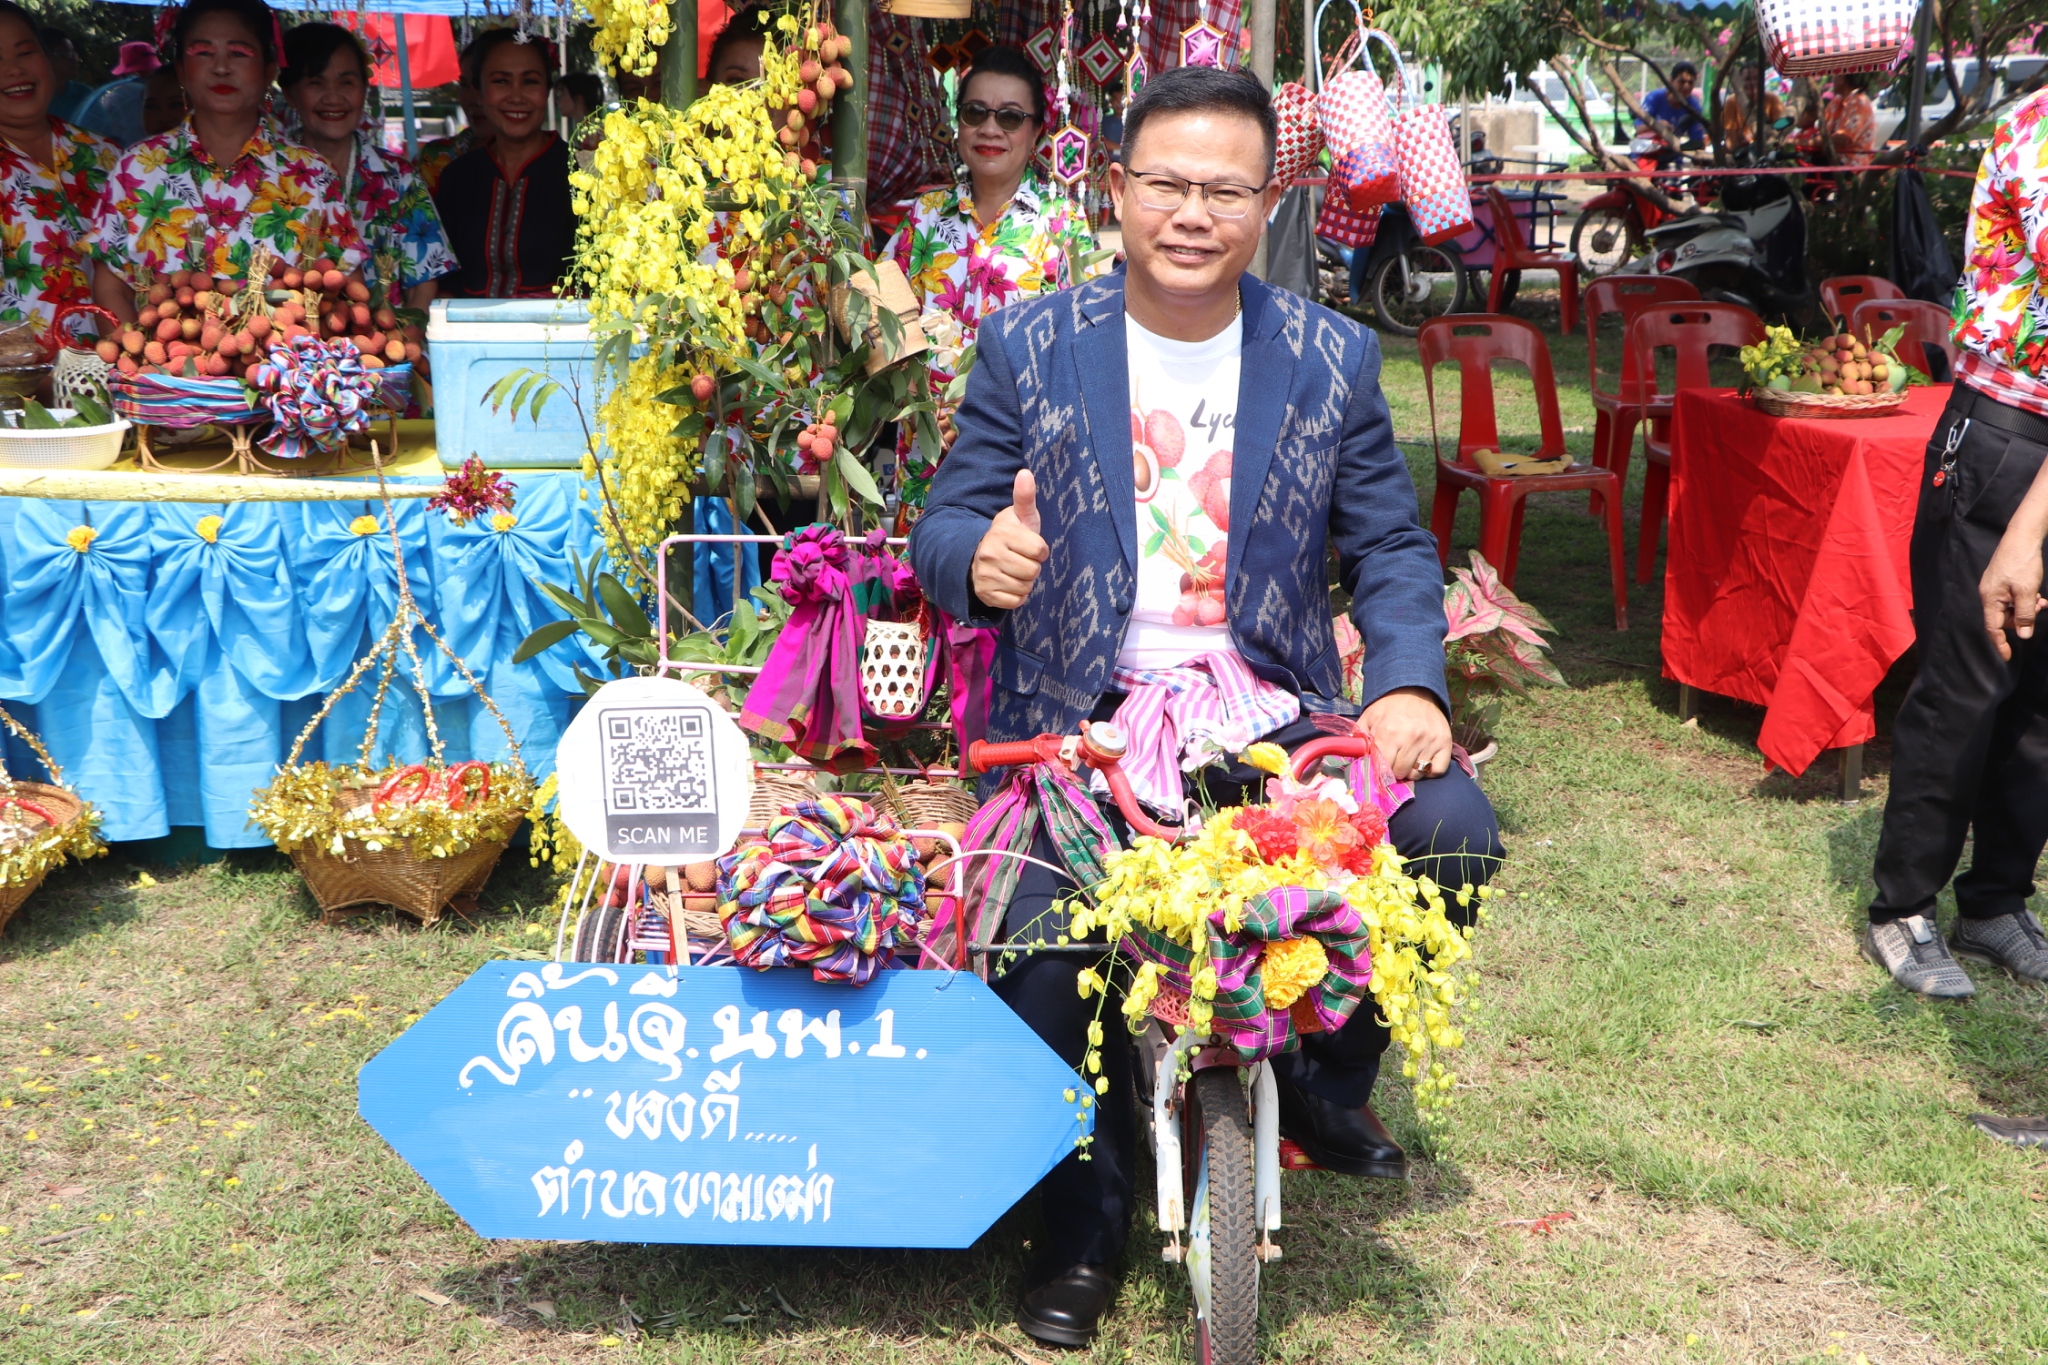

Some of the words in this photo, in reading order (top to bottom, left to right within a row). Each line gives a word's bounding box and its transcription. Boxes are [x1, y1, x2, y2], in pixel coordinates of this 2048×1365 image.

[1190, 398, 1237, 443] Lyc
[617, 826, 671, 845] SCAN
[679, 826, 709, 844] ME
